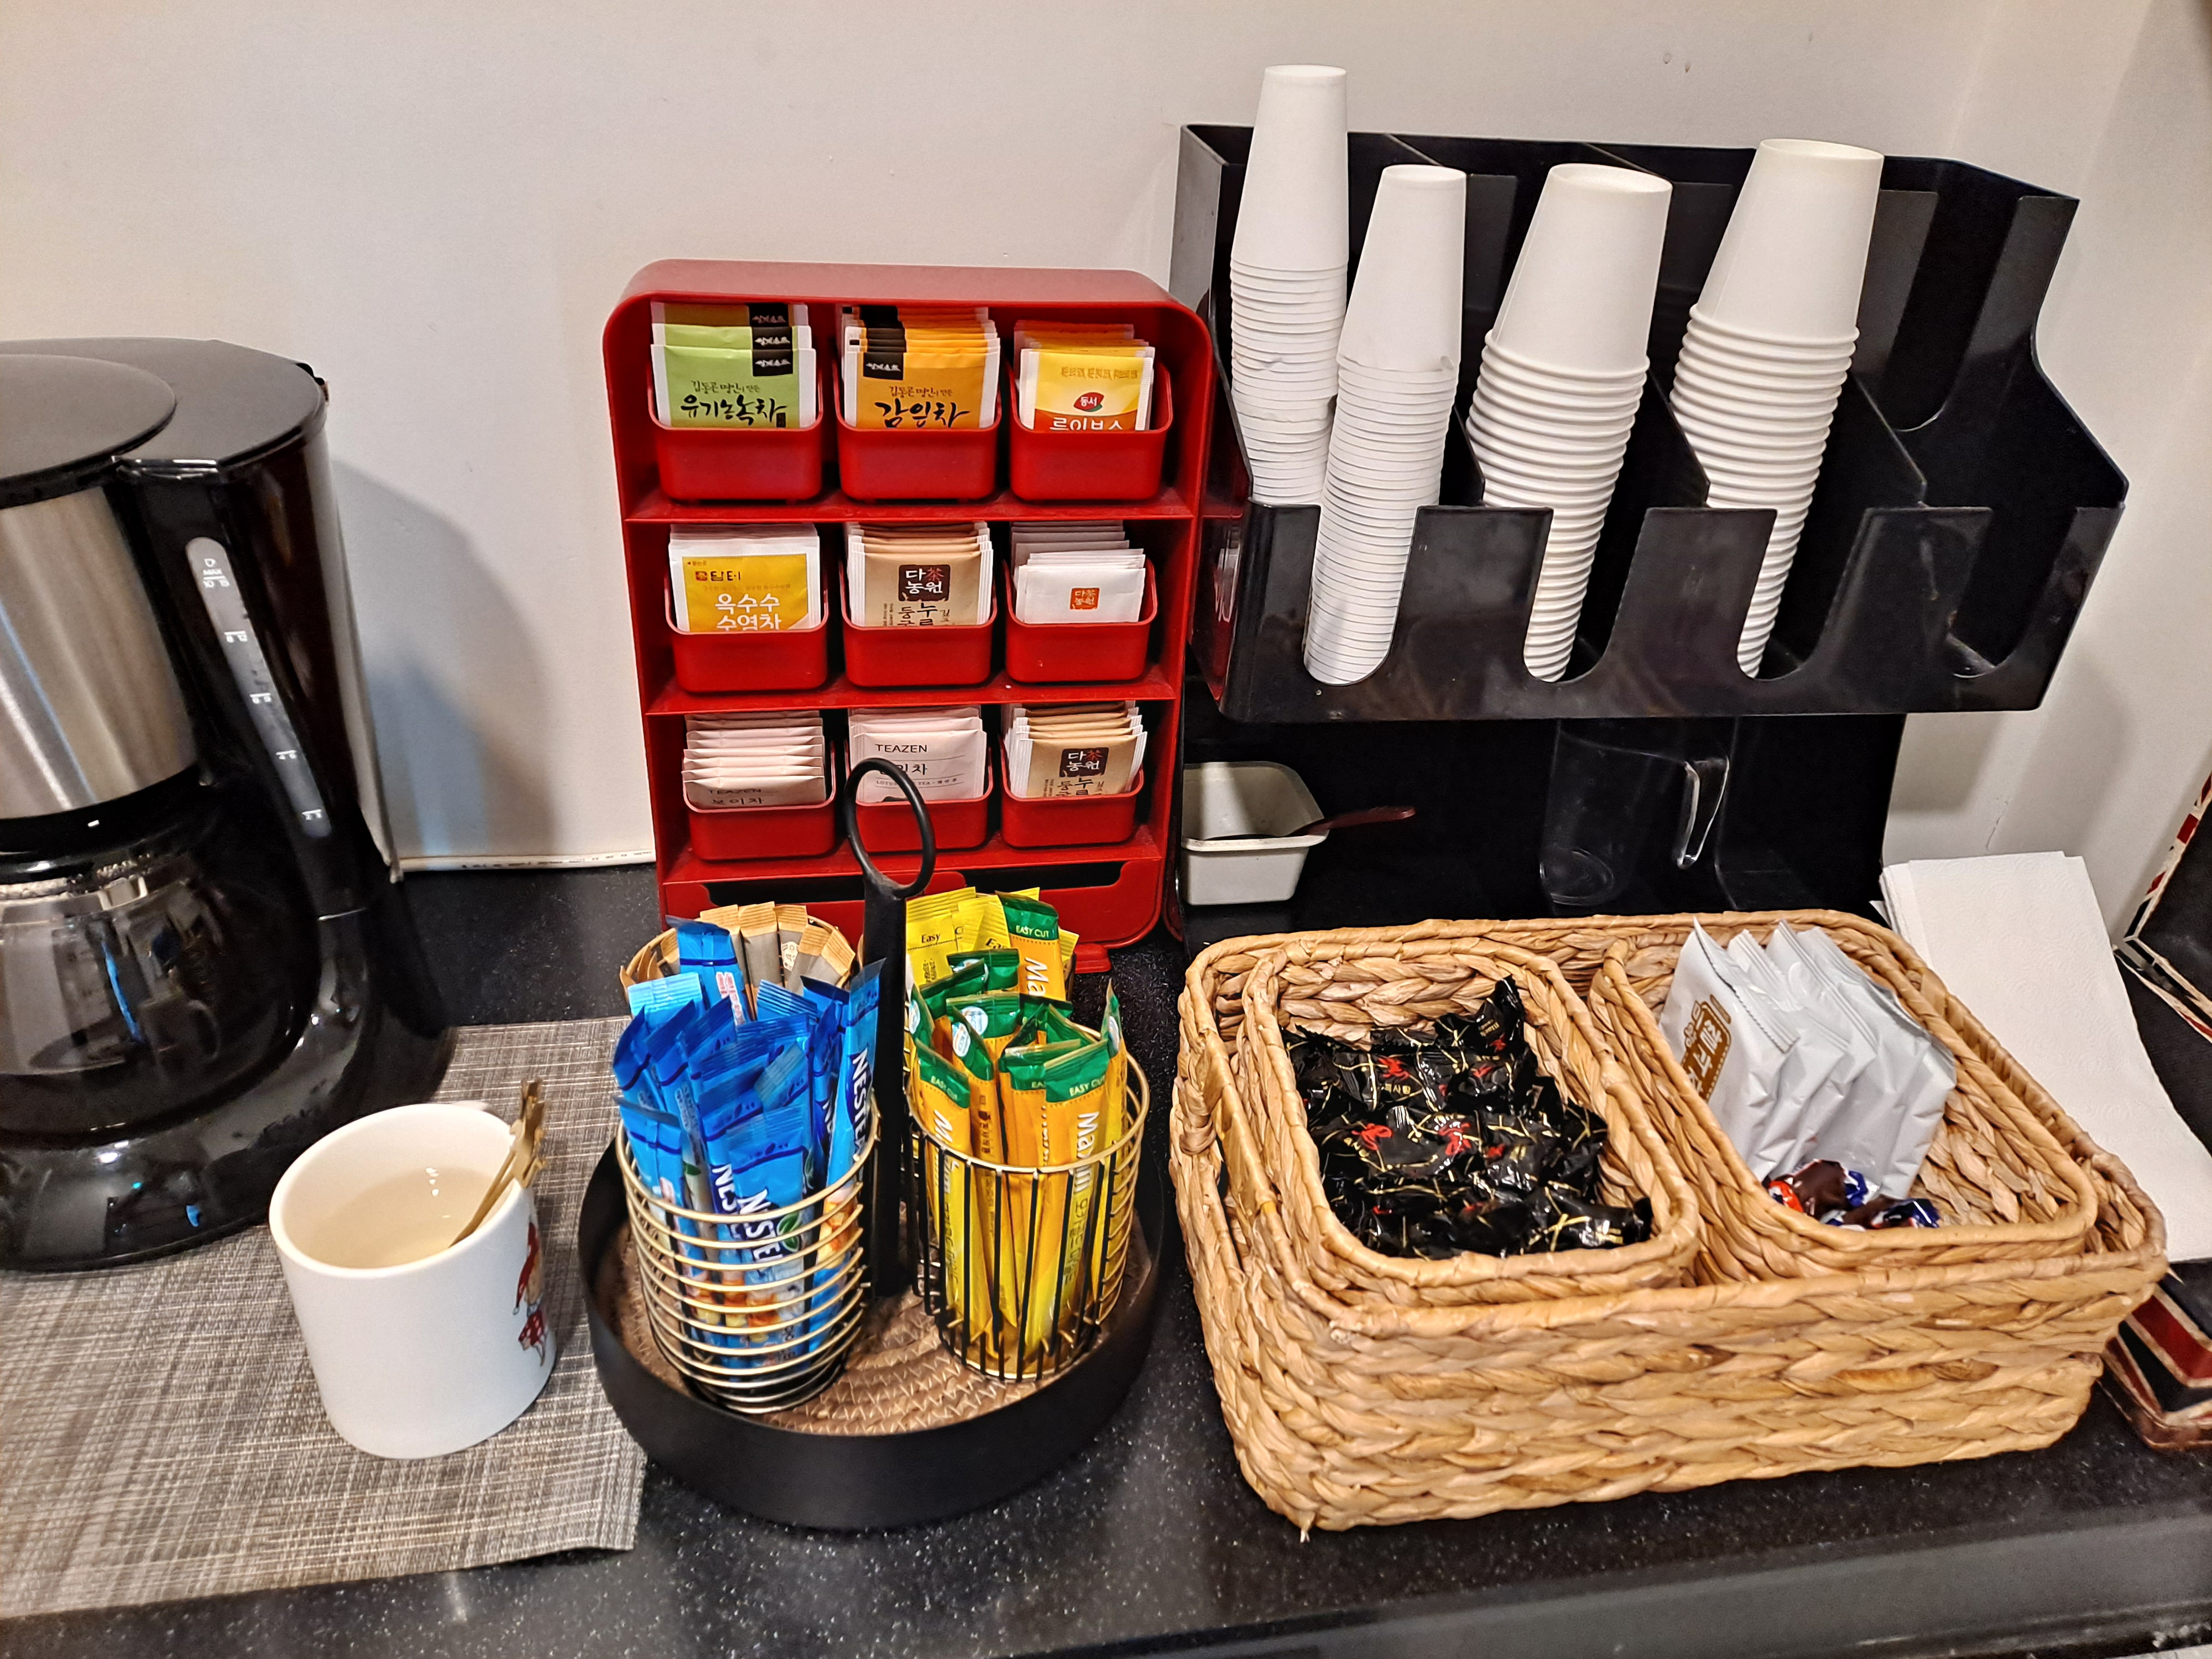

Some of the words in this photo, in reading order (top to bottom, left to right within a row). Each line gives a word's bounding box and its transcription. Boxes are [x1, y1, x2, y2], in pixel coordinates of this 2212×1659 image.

[1080, 397, 1097, 407] 동서
[715, 593, 780, 615] 옥수수
[717, 613, 782, 632] 수염차
[875, 744, 927, 753] TEAZEN
[921, 933, 940, 943] Easy
[1069, 1083, 1089, 1097] EASY
